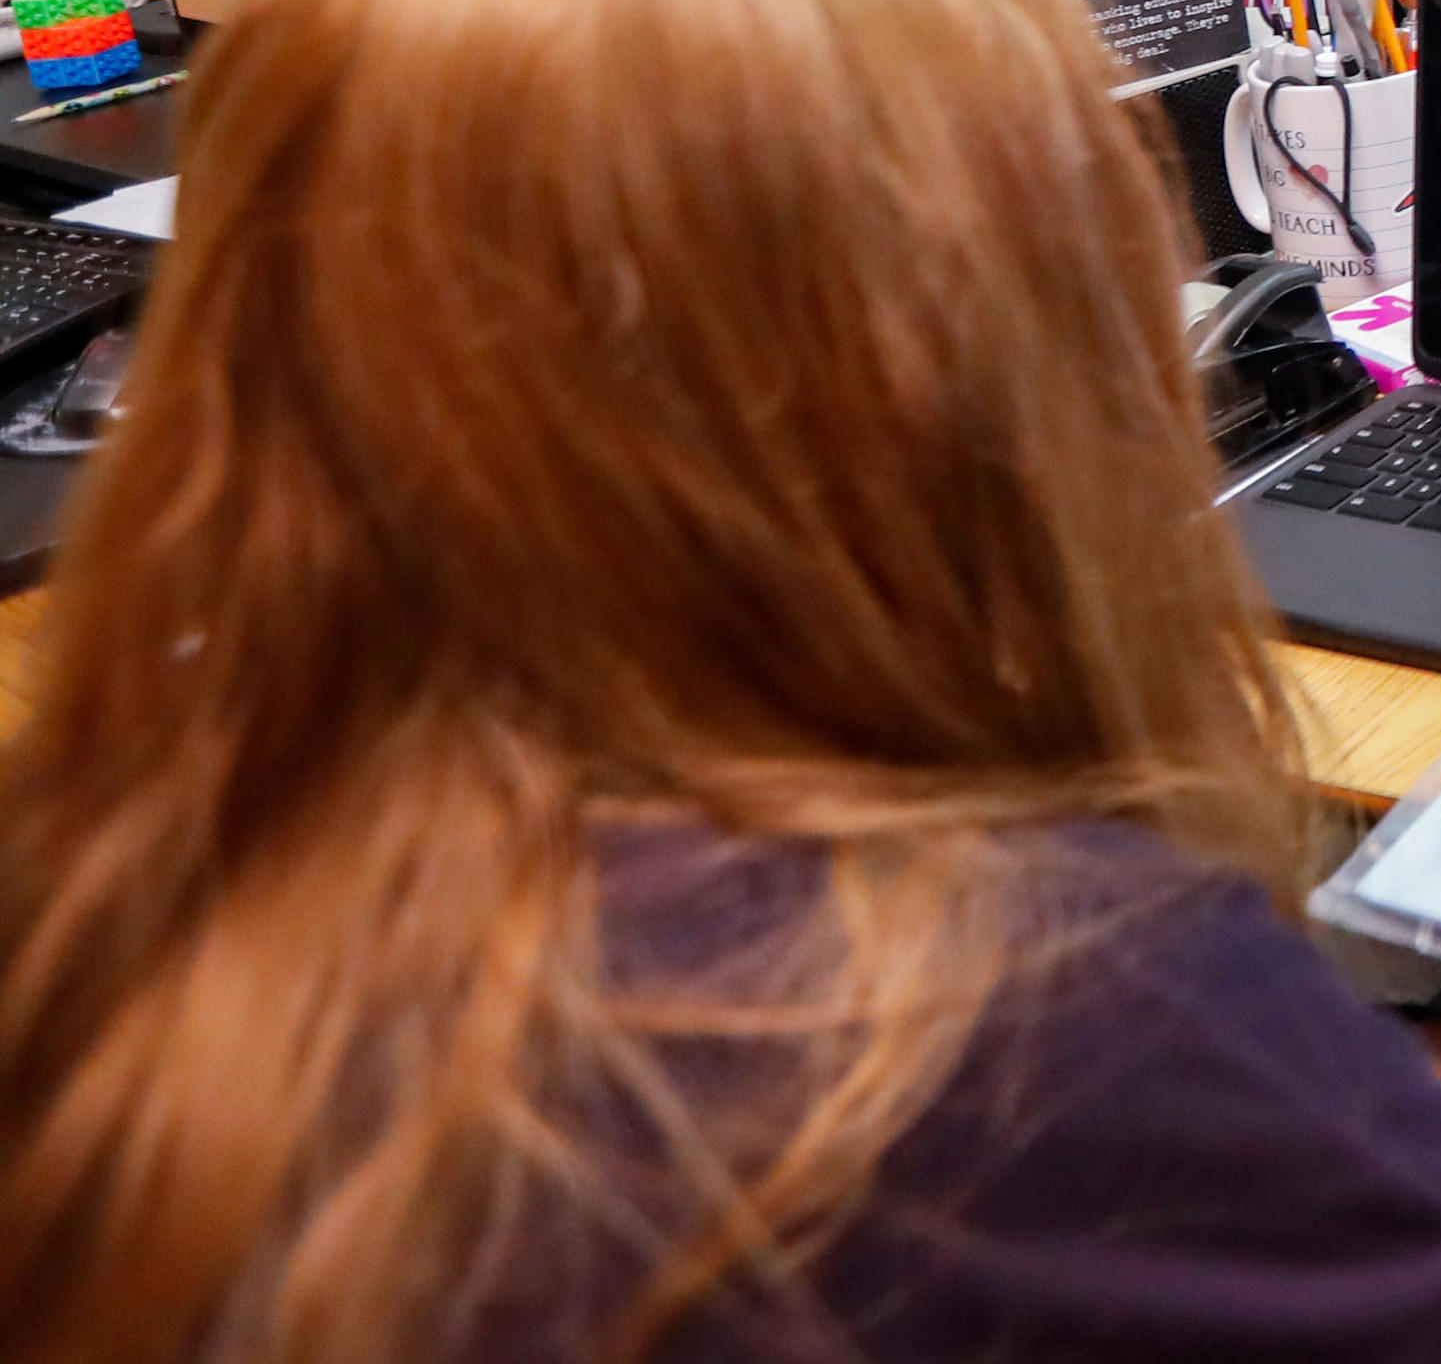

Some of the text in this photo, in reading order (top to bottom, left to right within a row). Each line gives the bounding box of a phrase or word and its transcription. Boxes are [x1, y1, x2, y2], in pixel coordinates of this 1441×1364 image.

[1102, 21, 1127, 36] who
[1129, 13, 1164, 30] lives
[1167, 10, 1182, 20] to
[1185, 13, 1230, 32] They're
[1277, 211, 1337, 236] TEACH
[1310, 258, 1376, 278] MINDS
